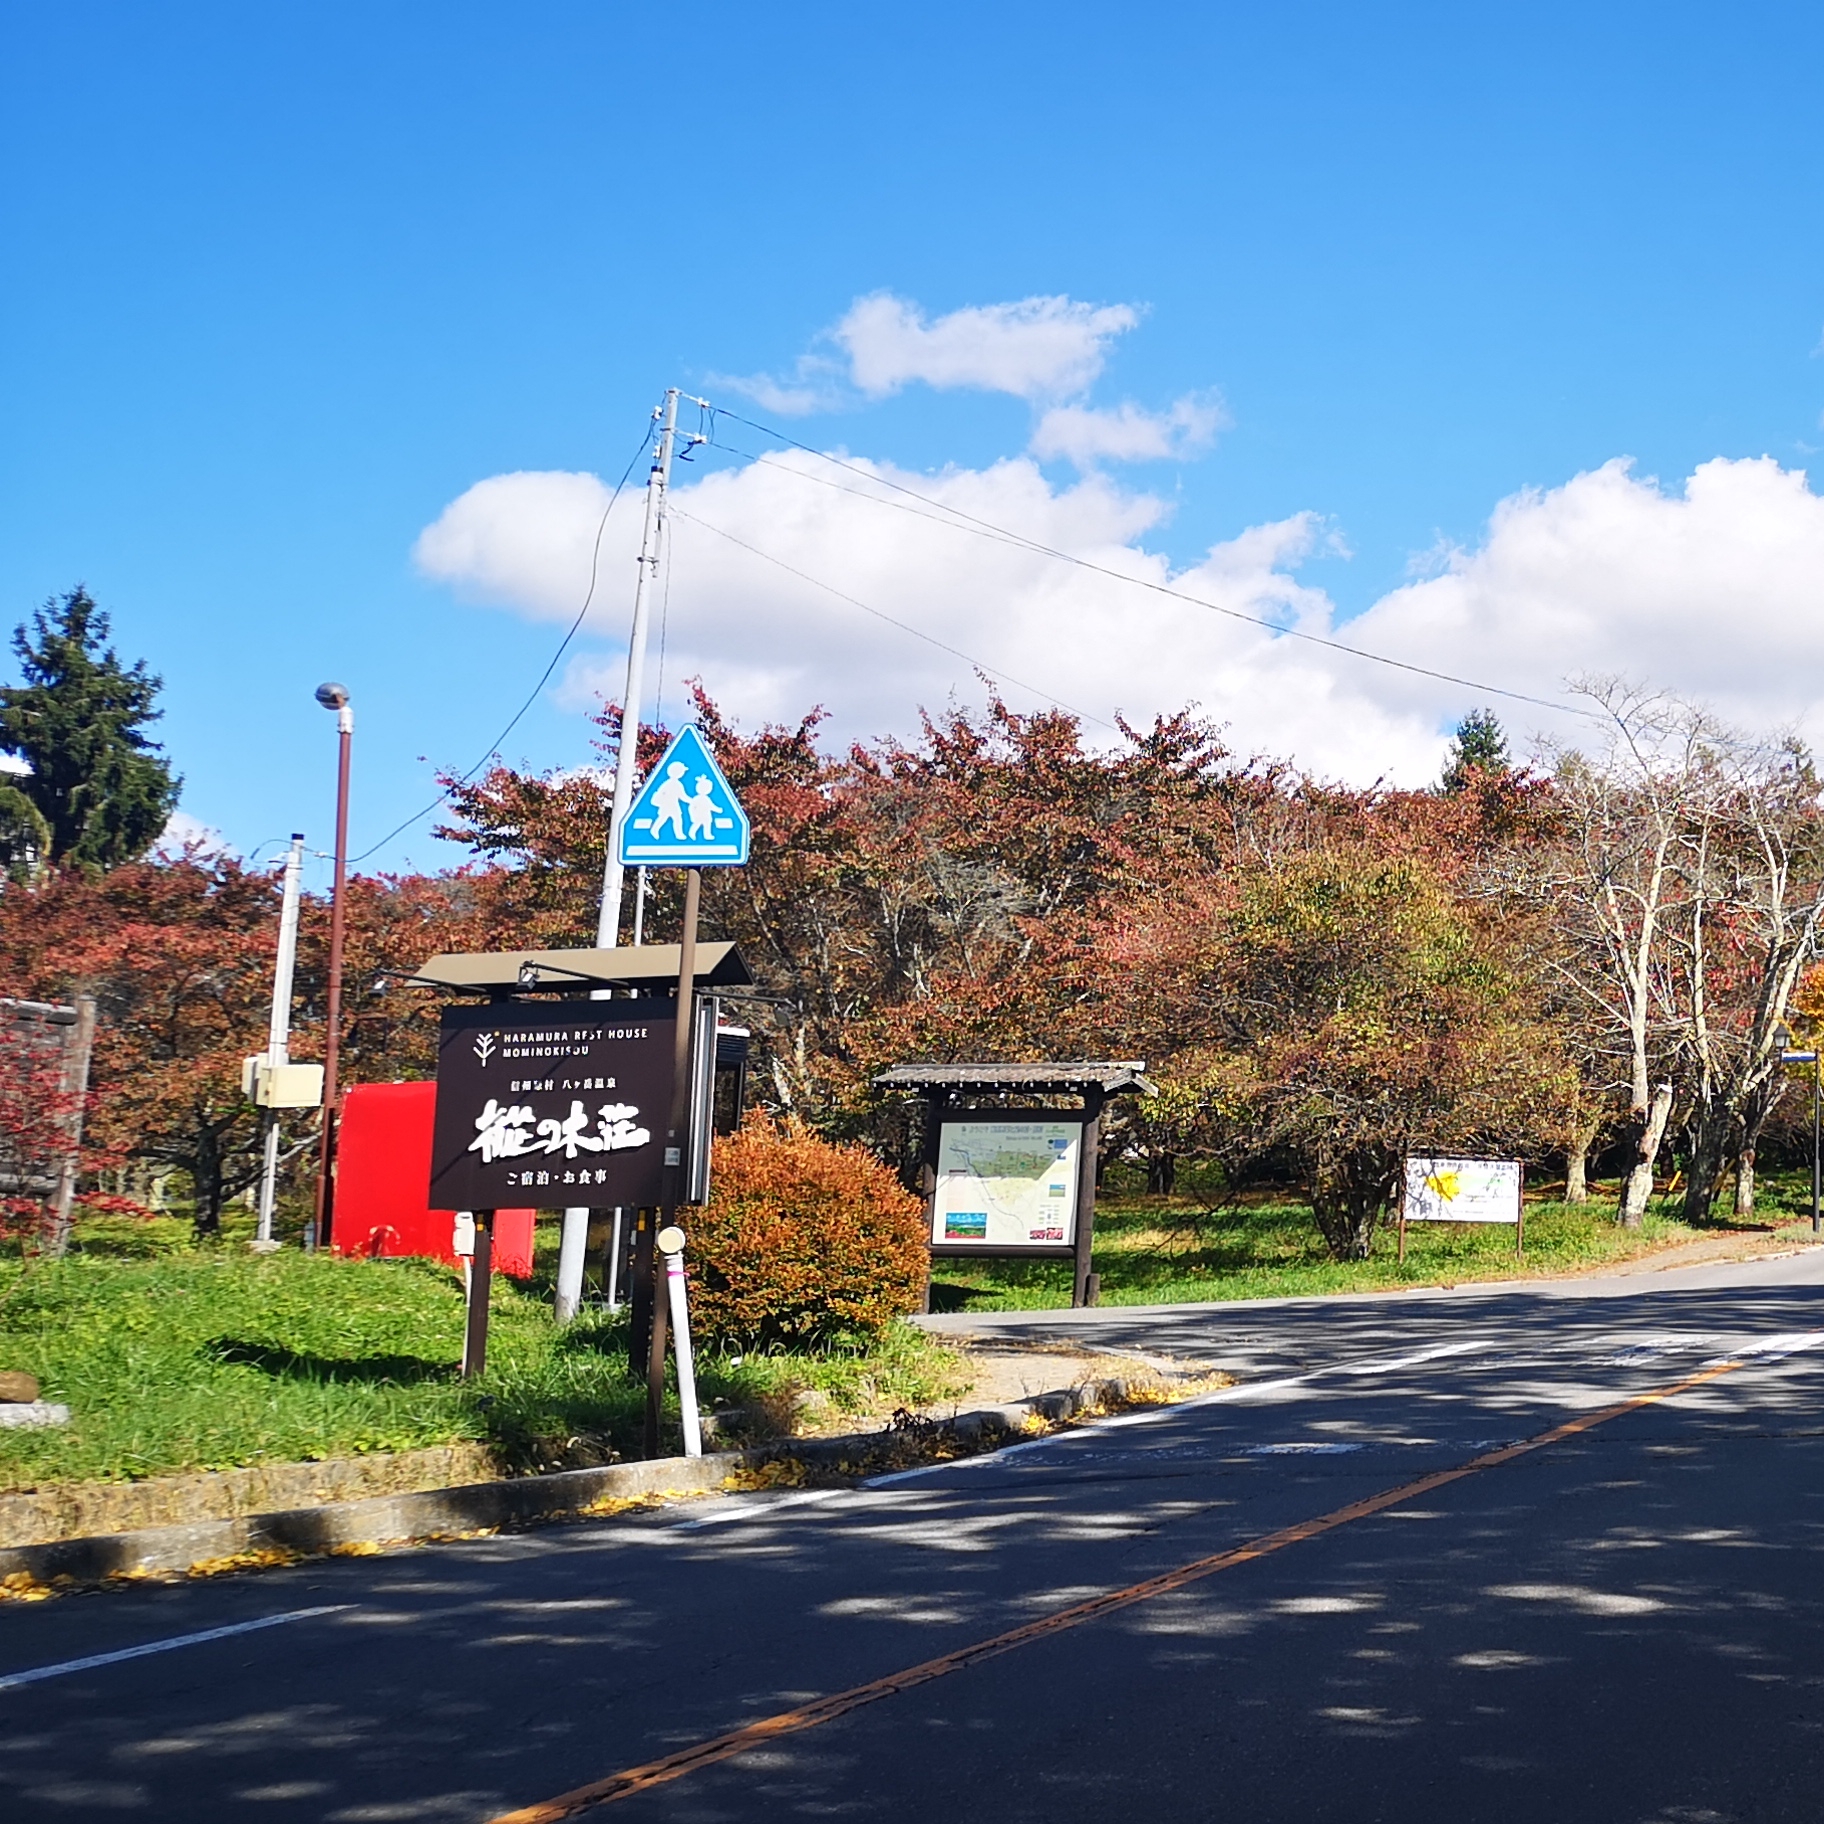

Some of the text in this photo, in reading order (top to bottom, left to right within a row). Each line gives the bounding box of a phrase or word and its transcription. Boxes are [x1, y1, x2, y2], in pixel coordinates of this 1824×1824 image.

[503, 1033, 568, 1043] HARAMURA
[608, 1028, 649, 1039] HOUSE
[502, 1045, 590, 1058] MOMINOKISOU
